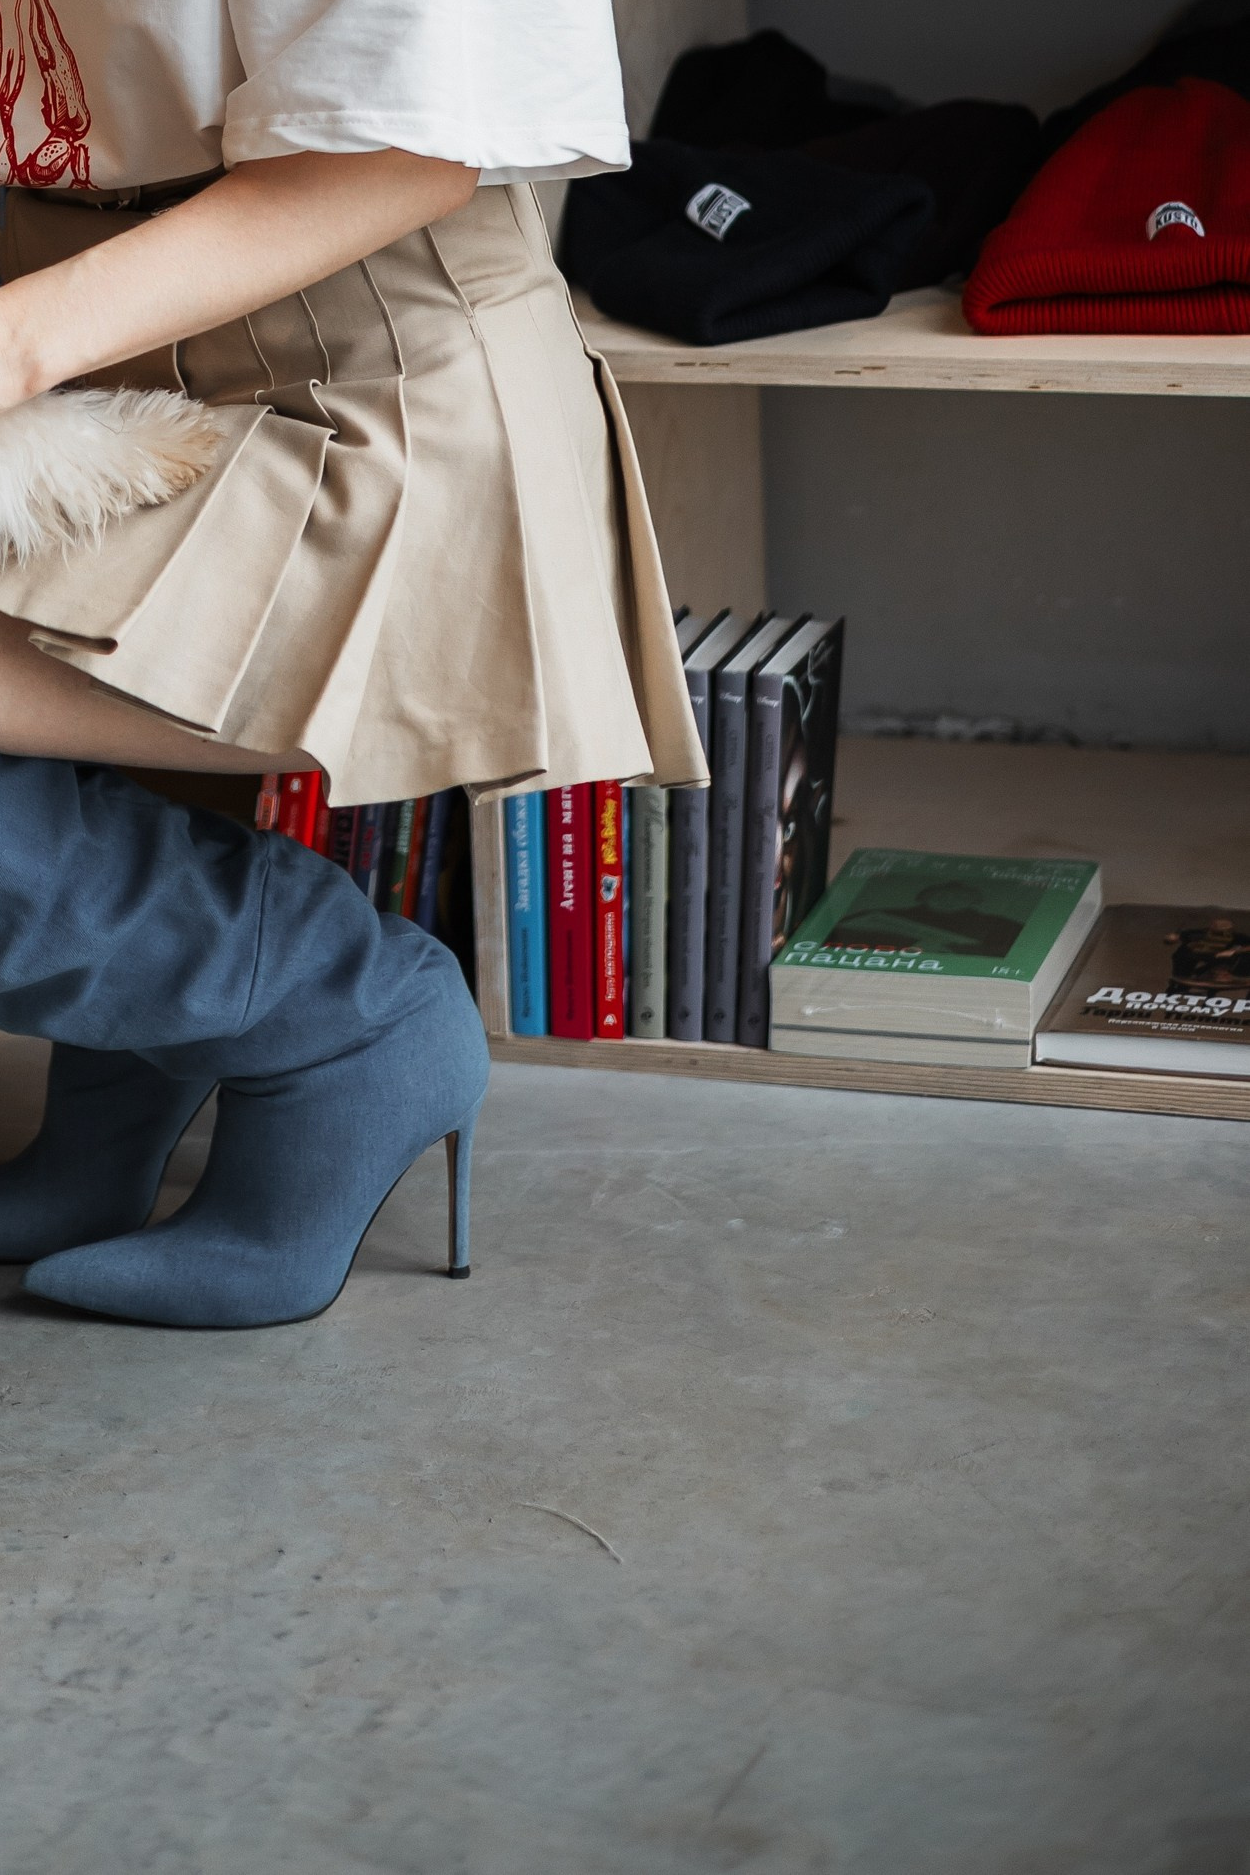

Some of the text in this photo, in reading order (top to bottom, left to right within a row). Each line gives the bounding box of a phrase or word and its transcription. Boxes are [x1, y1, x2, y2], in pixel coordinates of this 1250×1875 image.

[559, 832, 576, 911] Агент на
[514, 849, 531, 913] Загадка
[793, 940, 923, 957] слово
[784, 952, 944, 971] пацана
[1124, 1001, 1232, 1017] почему
[1163, 1012, 1250, 1026] Потте
